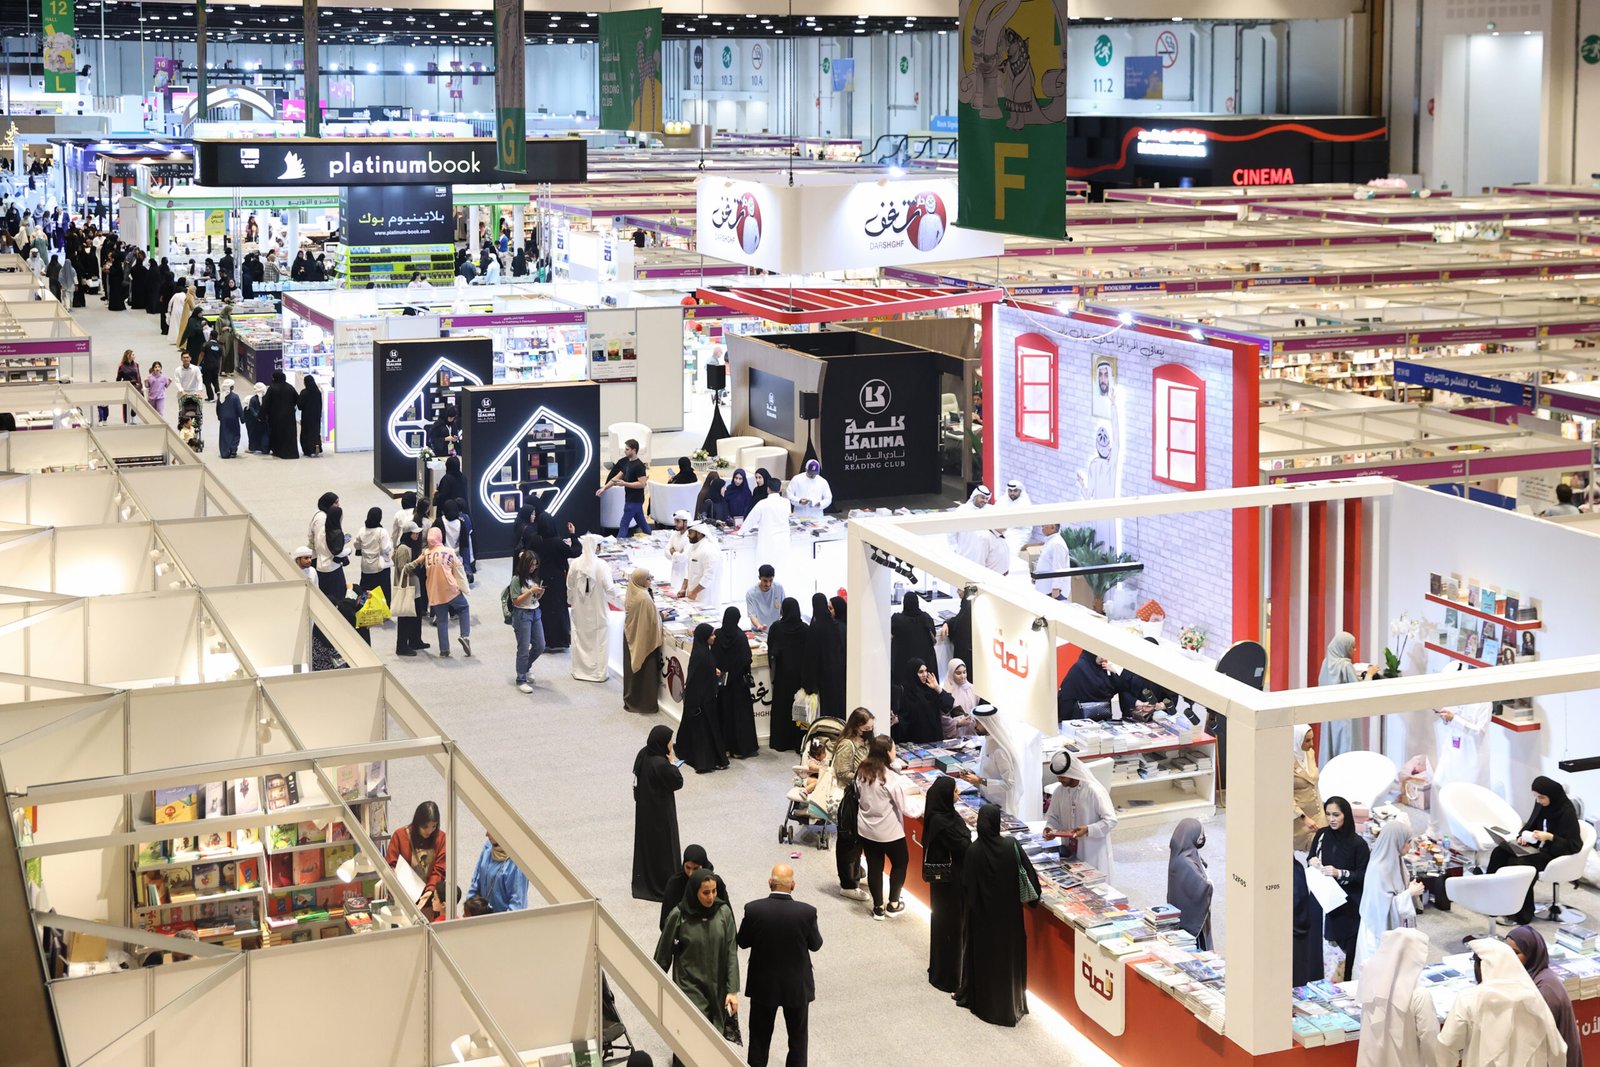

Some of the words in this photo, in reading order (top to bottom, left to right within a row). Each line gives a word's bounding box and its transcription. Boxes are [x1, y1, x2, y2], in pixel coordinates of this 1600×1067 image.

[50, 1, 68, 16] 12
[56, 76, 66, 91] L
[721, 75, 733, 86] 10.3
[751, 75, 763, 86] 10.4
[1093, 78, 1113, 92] 11.2
[503, 118, 515, 165] G
[329, 151, 481, 178] platinumbook
[994, 142, 1029, 220] F
[1232, 168, 1294, 186] CINEMA
[358, 212, 385, 226] بوك
[388, 210, 445, 228] بلاتينيوم
[869, 240, 905, 251] DARSHGHF
[845, 415, 905, 434] كلمة
[845, 434, 905, 450] KALIMA
[884, 450, 905, 460] نادي
[1082, 952, 1114, 1002] قصة
